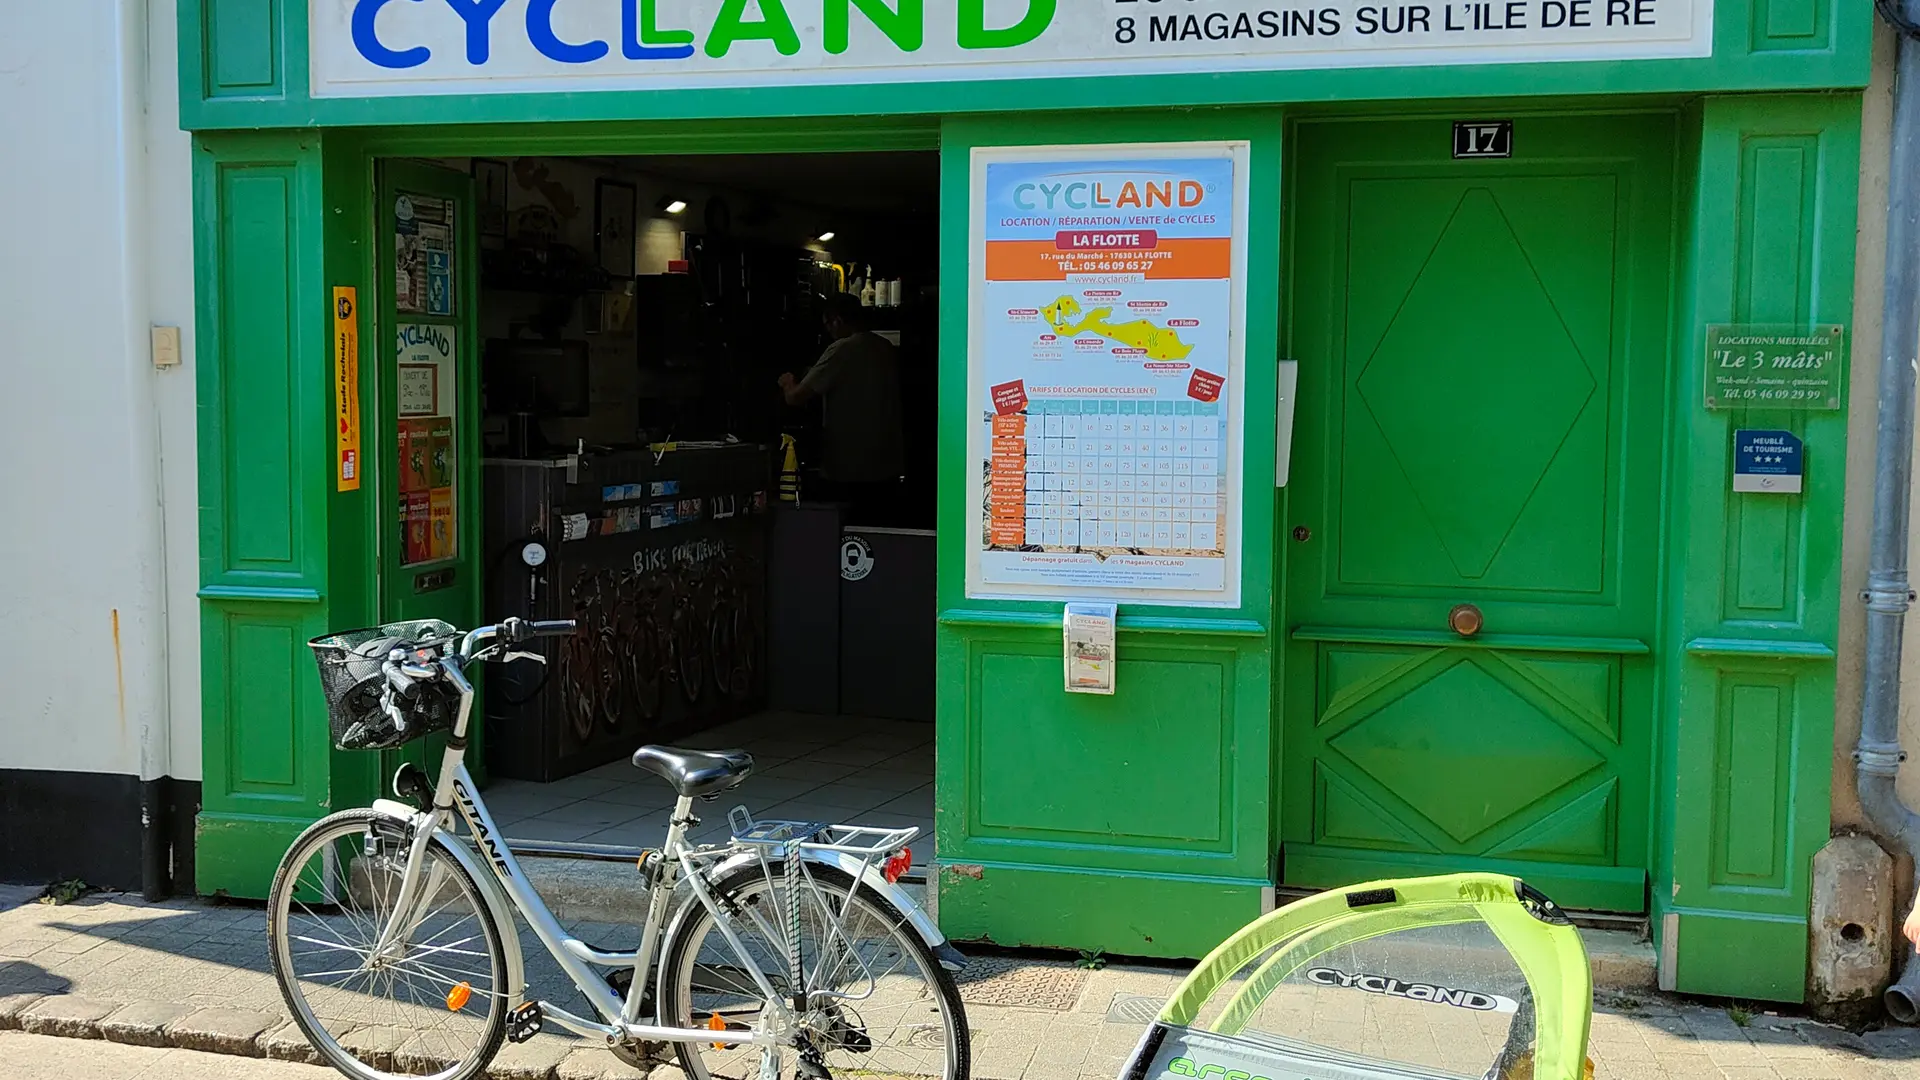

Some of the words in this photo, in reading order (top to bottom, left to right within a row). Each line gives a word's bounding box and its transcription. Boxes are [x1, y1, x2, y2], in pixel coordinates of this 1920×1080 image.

[1114, 17, 1136, 44] 8
[1149, 8, 1341, 42] MAGASINS
[1355, 5, 1430, 35] SUR
[1541, 1, 1591, 28] DE
[1467, 127, 1499, 152] 17
[1001, 217, 1050, 227] LOCATION
[1058, 214, 1120, 226] RÉPARATION
[1128, 215, 1161, 225] VENTE
[1163, 215, 1176, 224] de
[1178, 214, 1215, 224] CYCLES
[1073, 234, 1090, 246] LA
[1092, 234, 1140, 246] FLOTTE
[1076, 252, 1103, 260] Marché
[1084, 262, 1096, 270] 05
[1098, 262, 1110, 270] 46
[1112, 262, 1125, 270] 09
[1126, 261, 1139, 270] 65
[1140, 261, 1153, 269] 27
[1074, 274, 1136, 284] www.cycland.fr
[1718, 337, 1774, 345] LOCATIONS
[1776, 336, 1830, 345] MEUBLÉES
[1752, 351, 1764, 369] 3
[1744, 389, 1756, 398] 05
[1760, 389, 1772, 398] 46
[1776, 389, 1788, 398] 09
[1792, 389, 1804, 399] 29
[1807, 390, 1820, 399] 99
[1753, 436, 1784, 445] MEUBLÉ
[1755, 445, 1793, 453] TOURISME
[453, 779, 513, 878] GITANE
